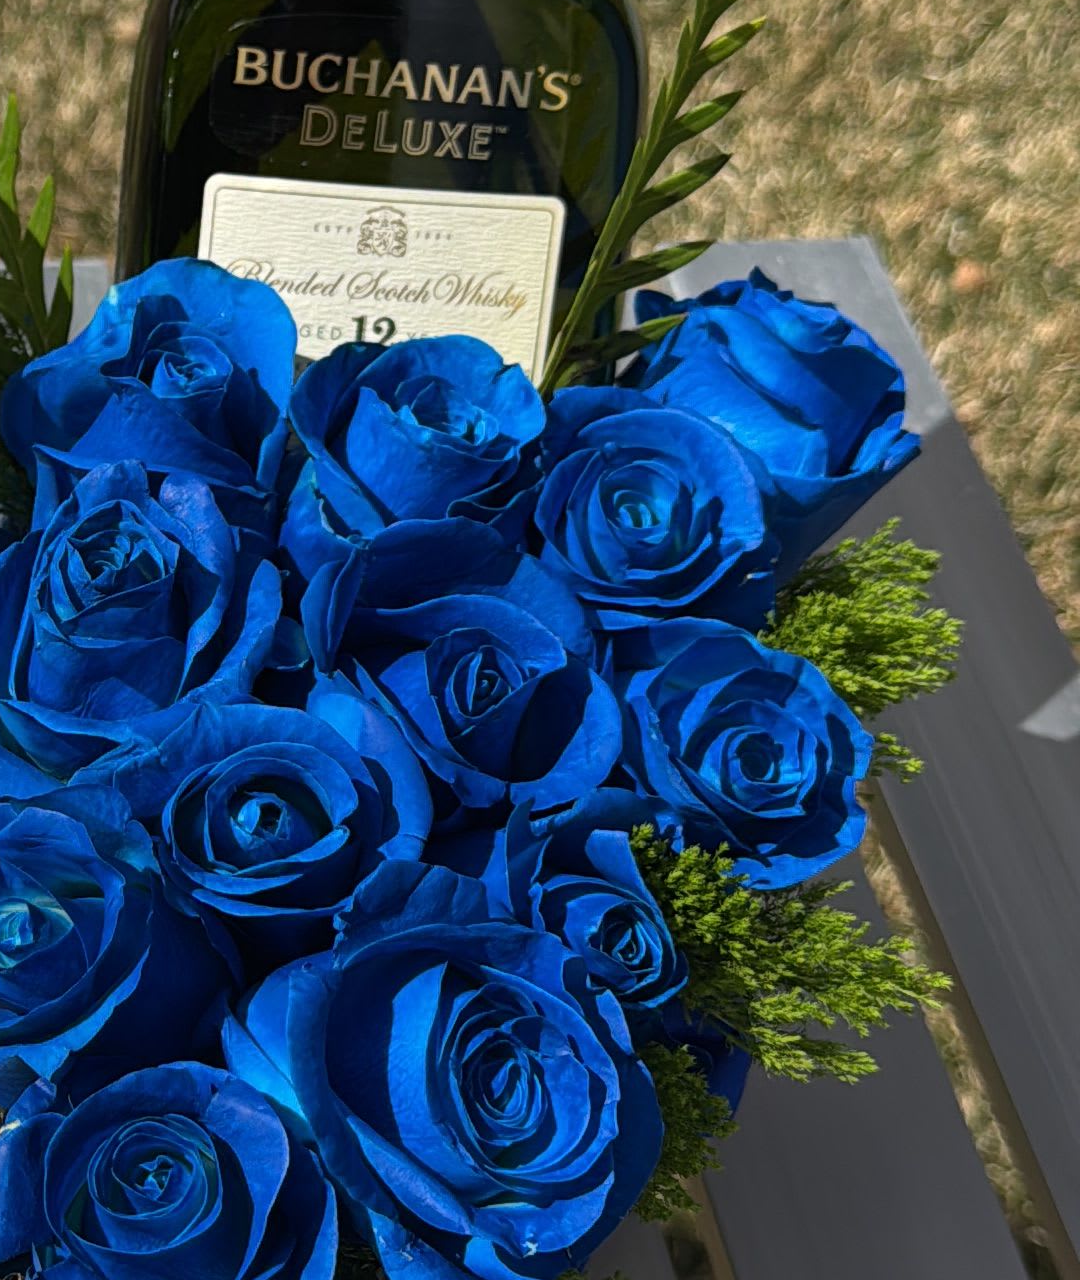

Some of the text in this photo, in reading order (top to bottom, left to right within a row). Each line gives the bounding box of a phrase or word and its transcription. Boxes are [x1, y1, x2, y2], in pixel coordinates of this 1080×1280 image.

[299, 103, 494, 161] DELUXE
[346, 268, 433, 305] Scotch
[432, 270, 528, 321] Whisky
[299, 322, 342, 342] GED
